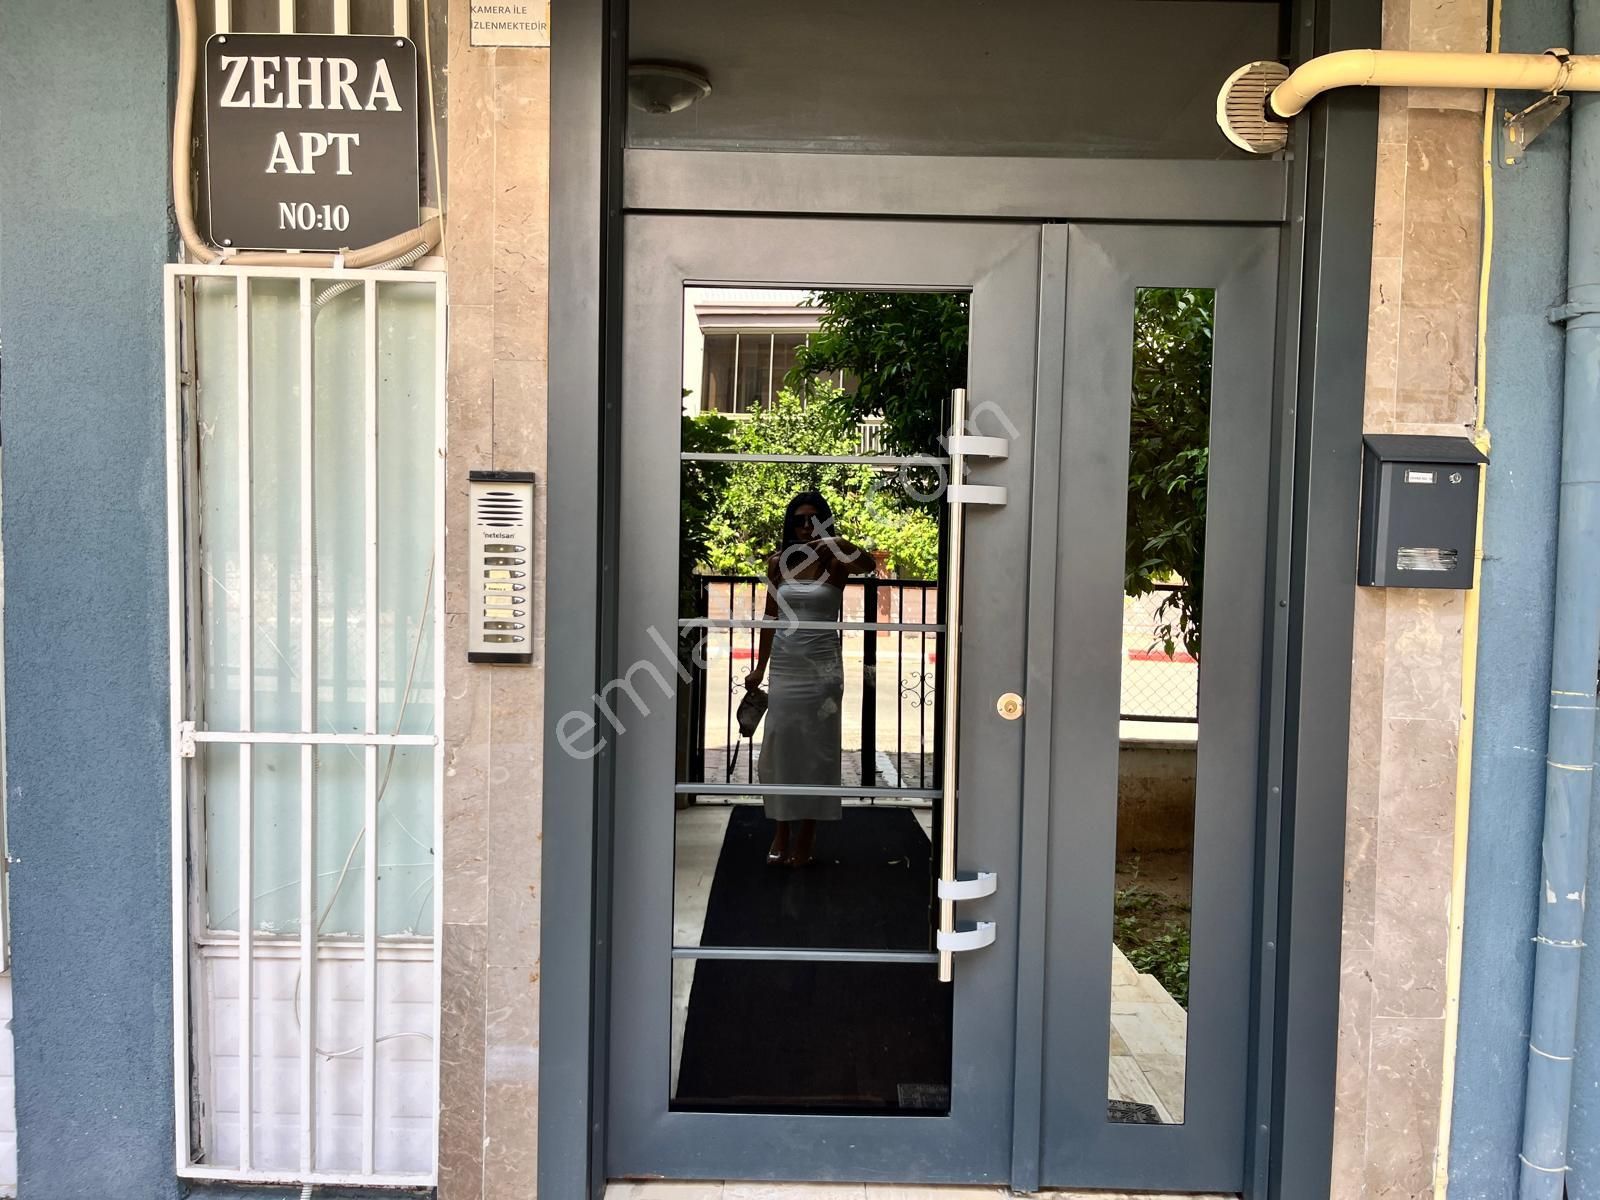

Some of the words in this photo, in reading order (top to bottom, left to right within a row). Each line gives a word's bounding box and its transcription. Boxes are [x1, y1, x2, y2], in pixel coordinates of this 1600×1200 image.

[471, 5, 511, 14] KAMERA
[513, 4, 527, 15] İLE
[220, 54, 403, 113] ZEHRA
[265, 130, 360, 176] APT
[278, 201, 350, 232] NO:10
